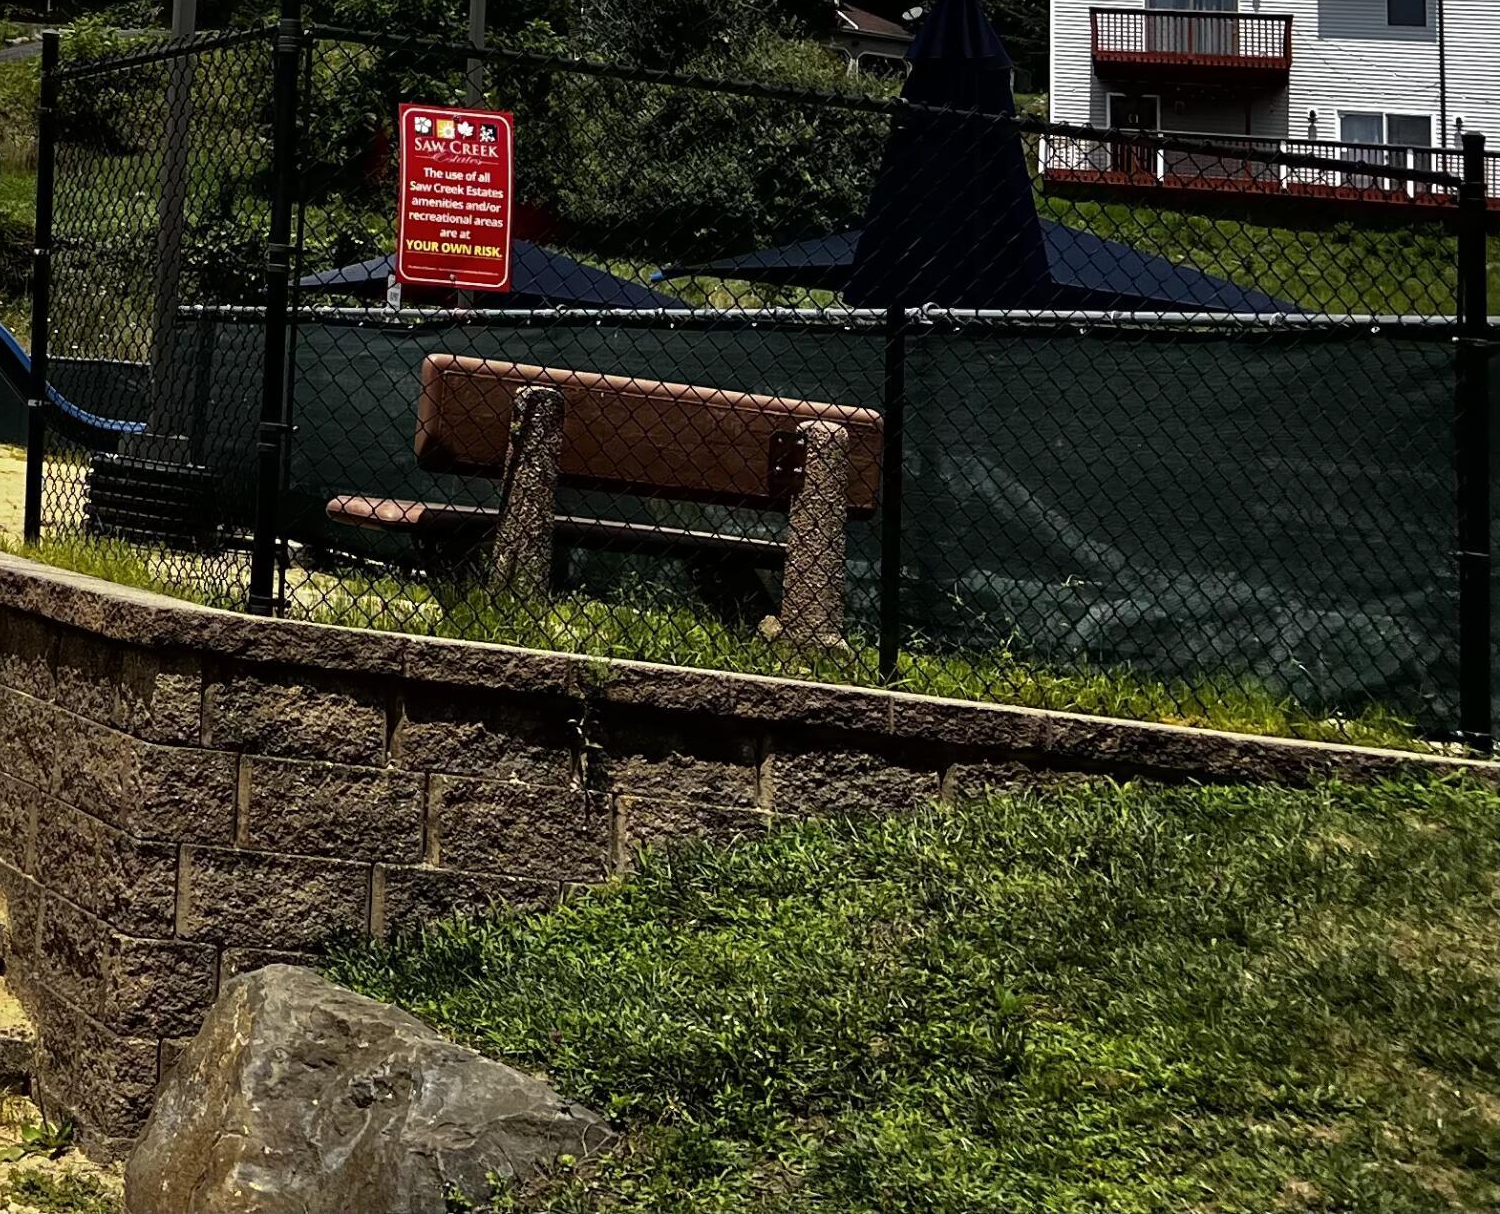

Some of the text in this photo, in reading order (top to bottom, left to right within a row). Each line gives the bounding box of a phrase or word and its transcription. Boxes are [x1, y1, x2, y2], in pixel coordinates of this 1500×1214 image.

[414, 137, 499, 158] SAW CREEK
[423, 167, 491, 183] The use of all
[409, 180, 504, 199] Saw Creek Estates
[411, 197, 502, 213] amenities and/or
[408, 211, 504, 228] recreational areas
[439, 229, 471, 240] are at
[406, 238, 503, 258] YOUR OWN RISK.
